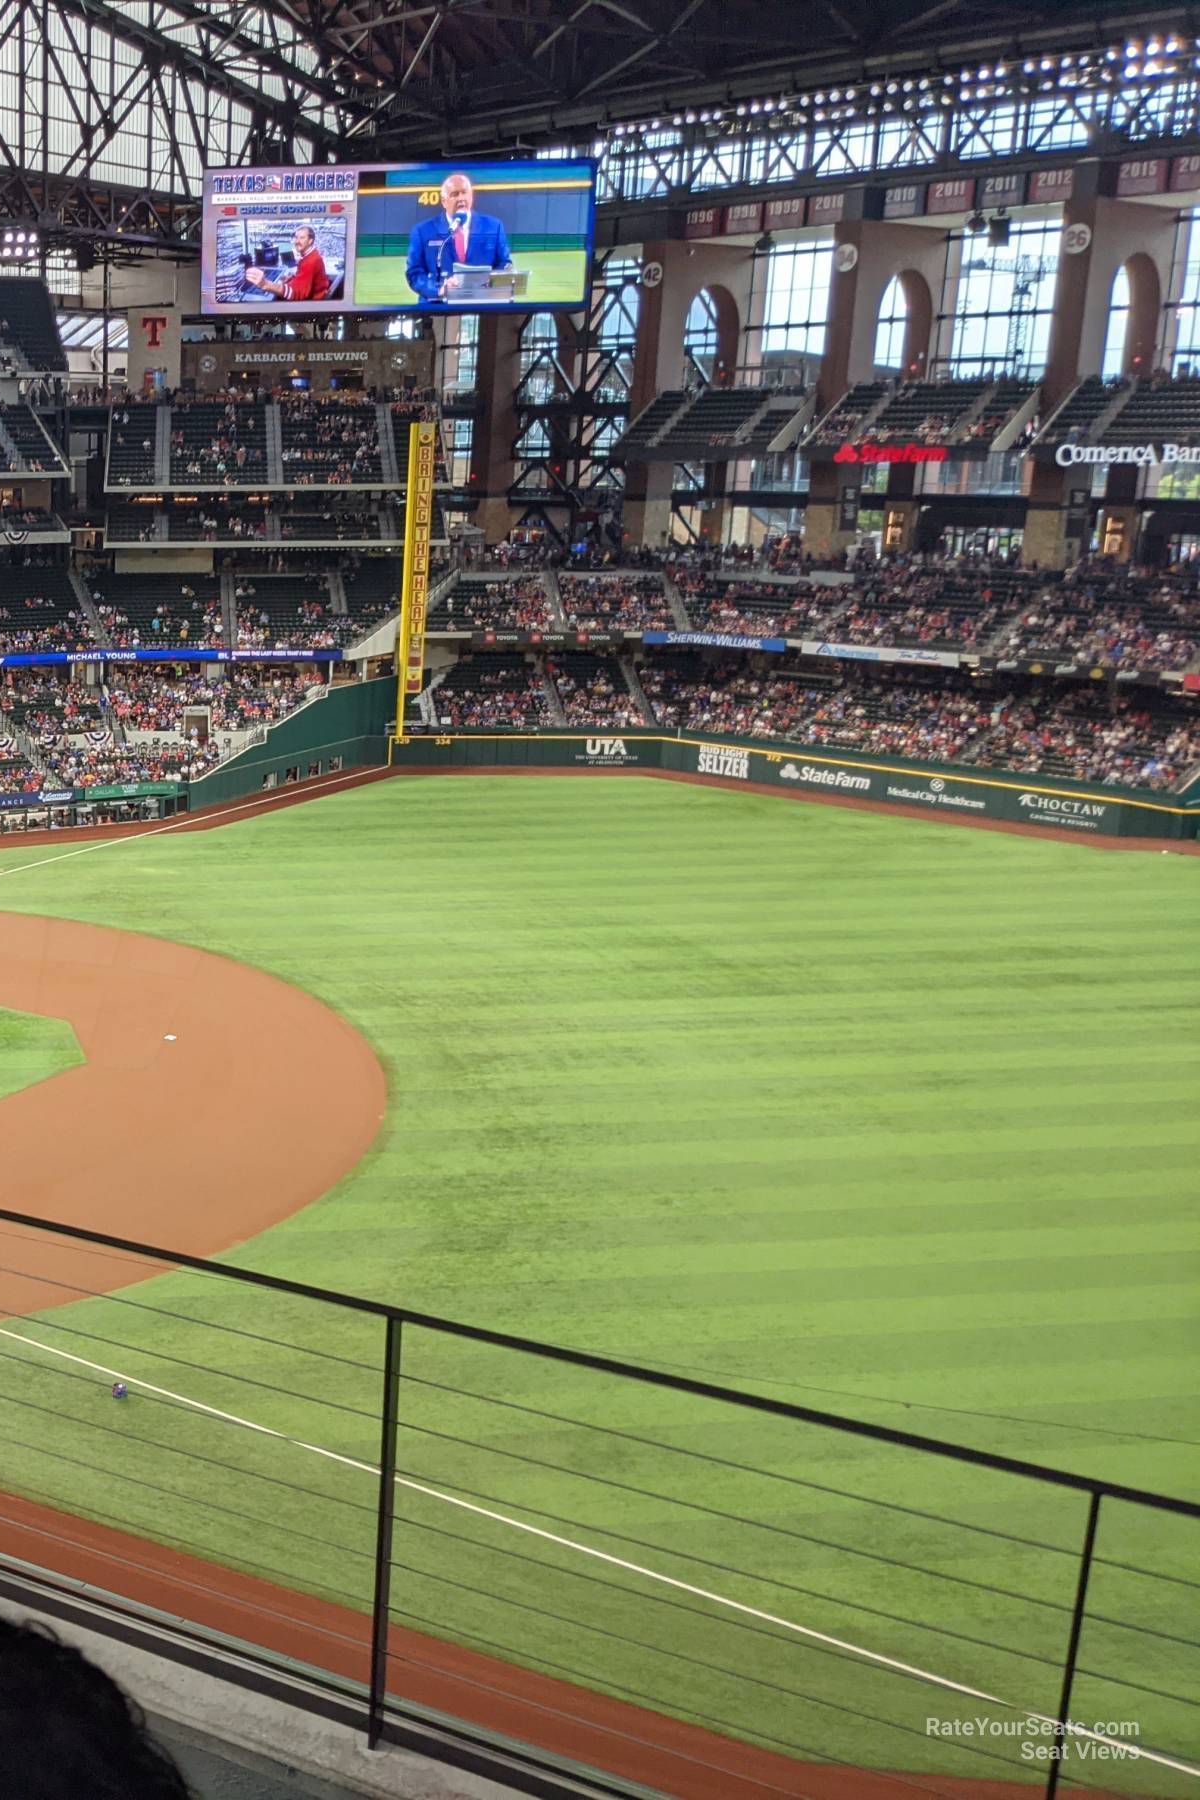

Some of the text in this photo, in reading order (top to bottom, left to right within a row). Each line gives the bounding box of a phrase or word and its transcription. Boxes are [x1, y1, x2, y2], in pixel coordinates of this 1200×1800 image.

[1038, 169, 1073, 186] 2012
[1120, 161, 1157, 178] 2015
[212, 172, 354, 193] TEXAS RANGERS
[936, 181, 966, 197] 2011
[985, 176, 1016, 192] 2011
[240, 205, 277, 215] CHUCK
[1066, 230, 1088, 247] 26
[644, 267, 660, 281] 42
[141, 316, 167, 347] T
[235, 351, 368, 363] KARBACH BREWING
[410, 447, 431, 635] BRING THE HEAT
[67, 652, 137, 662] MICHAEL YOUNG
[586, 739, 627, 755] UTA
[700, 744, 749, 758] BUD LIGHT
[697, 754, 748, 779] SELTZER
[887, 786, 986, 809] Medical City Healthcare
[1025, 794, 1106, 816] CHOCTAW
